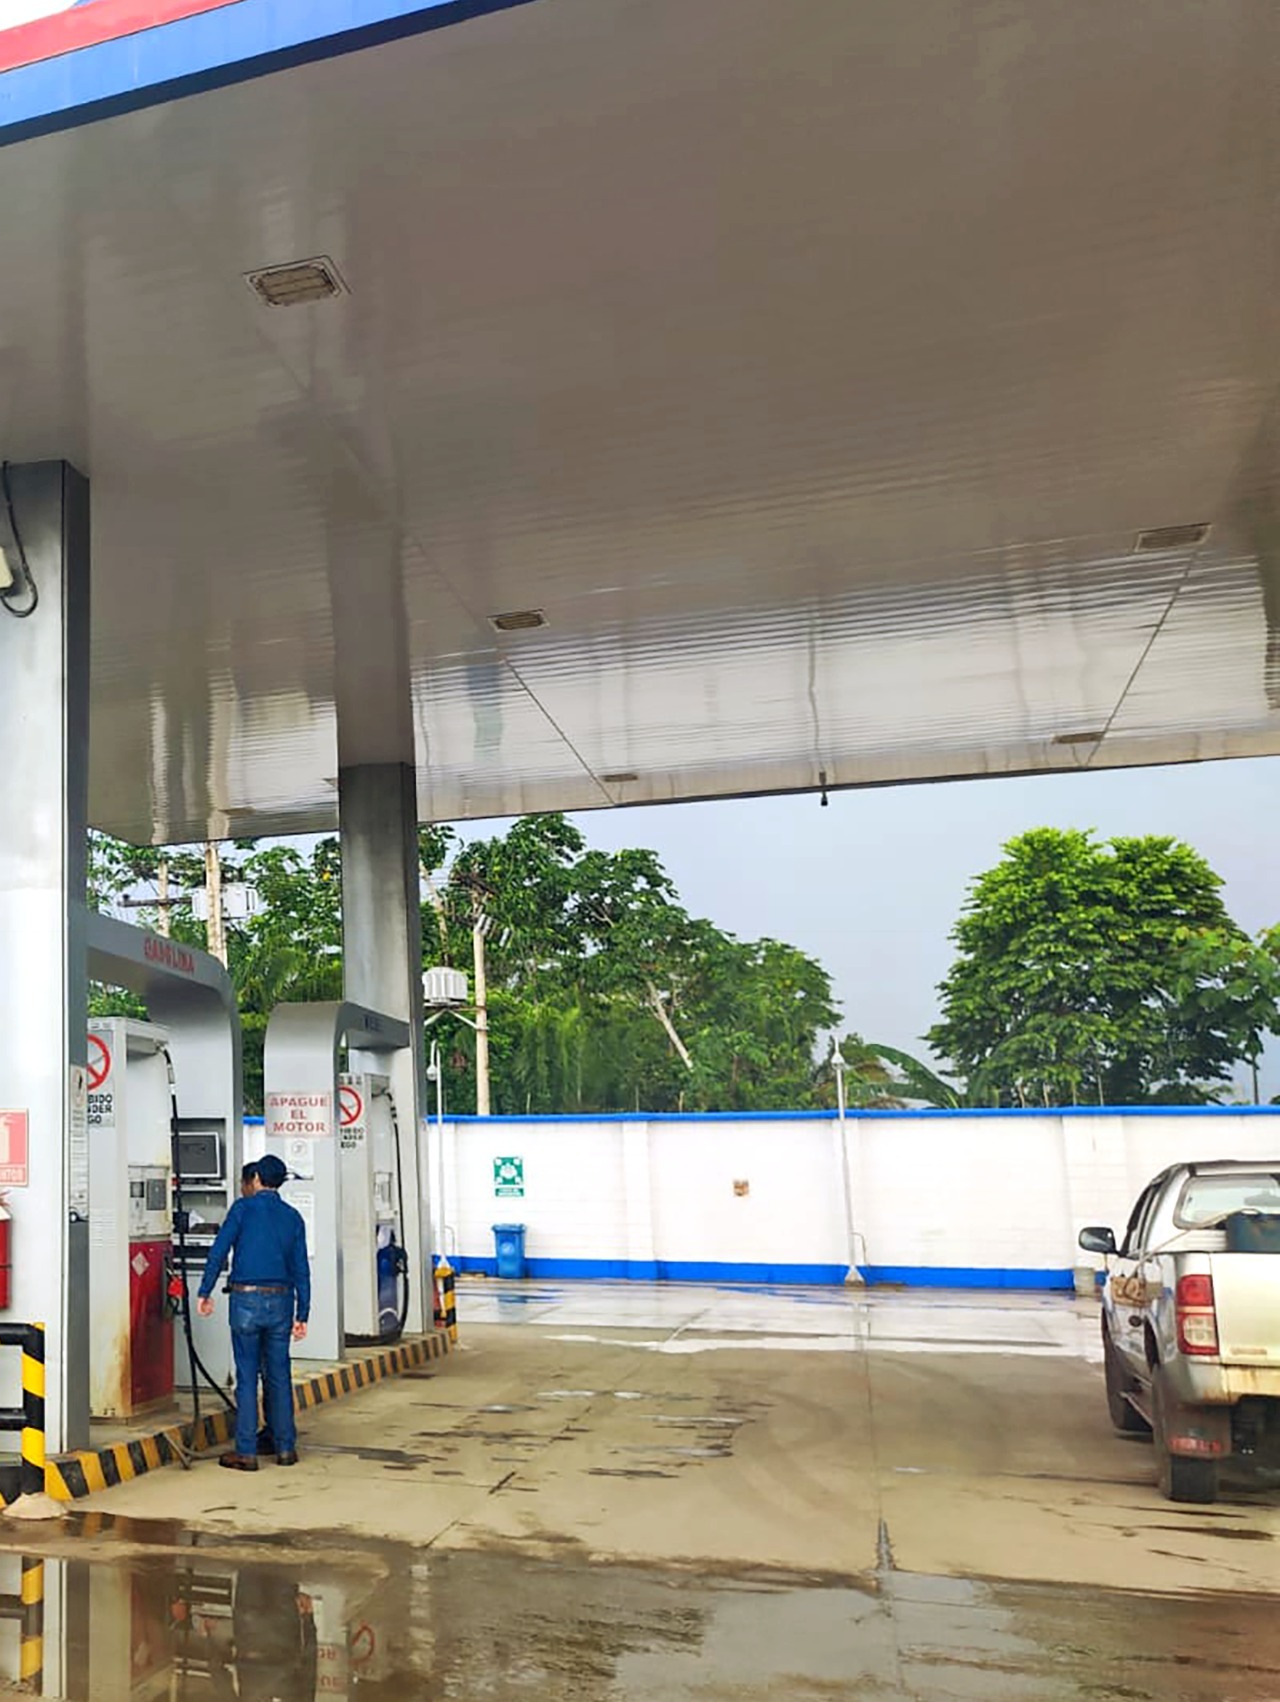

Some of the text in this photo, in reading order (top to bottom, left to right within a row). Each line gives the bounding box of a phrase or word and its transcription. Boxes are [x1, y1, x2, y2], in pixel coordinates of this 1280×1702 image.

[270, 1096, 328, 1107] APAGUE
[290, 1109, 307, 1119] EL
[273, 1121, 326, 1132] MOTOR
